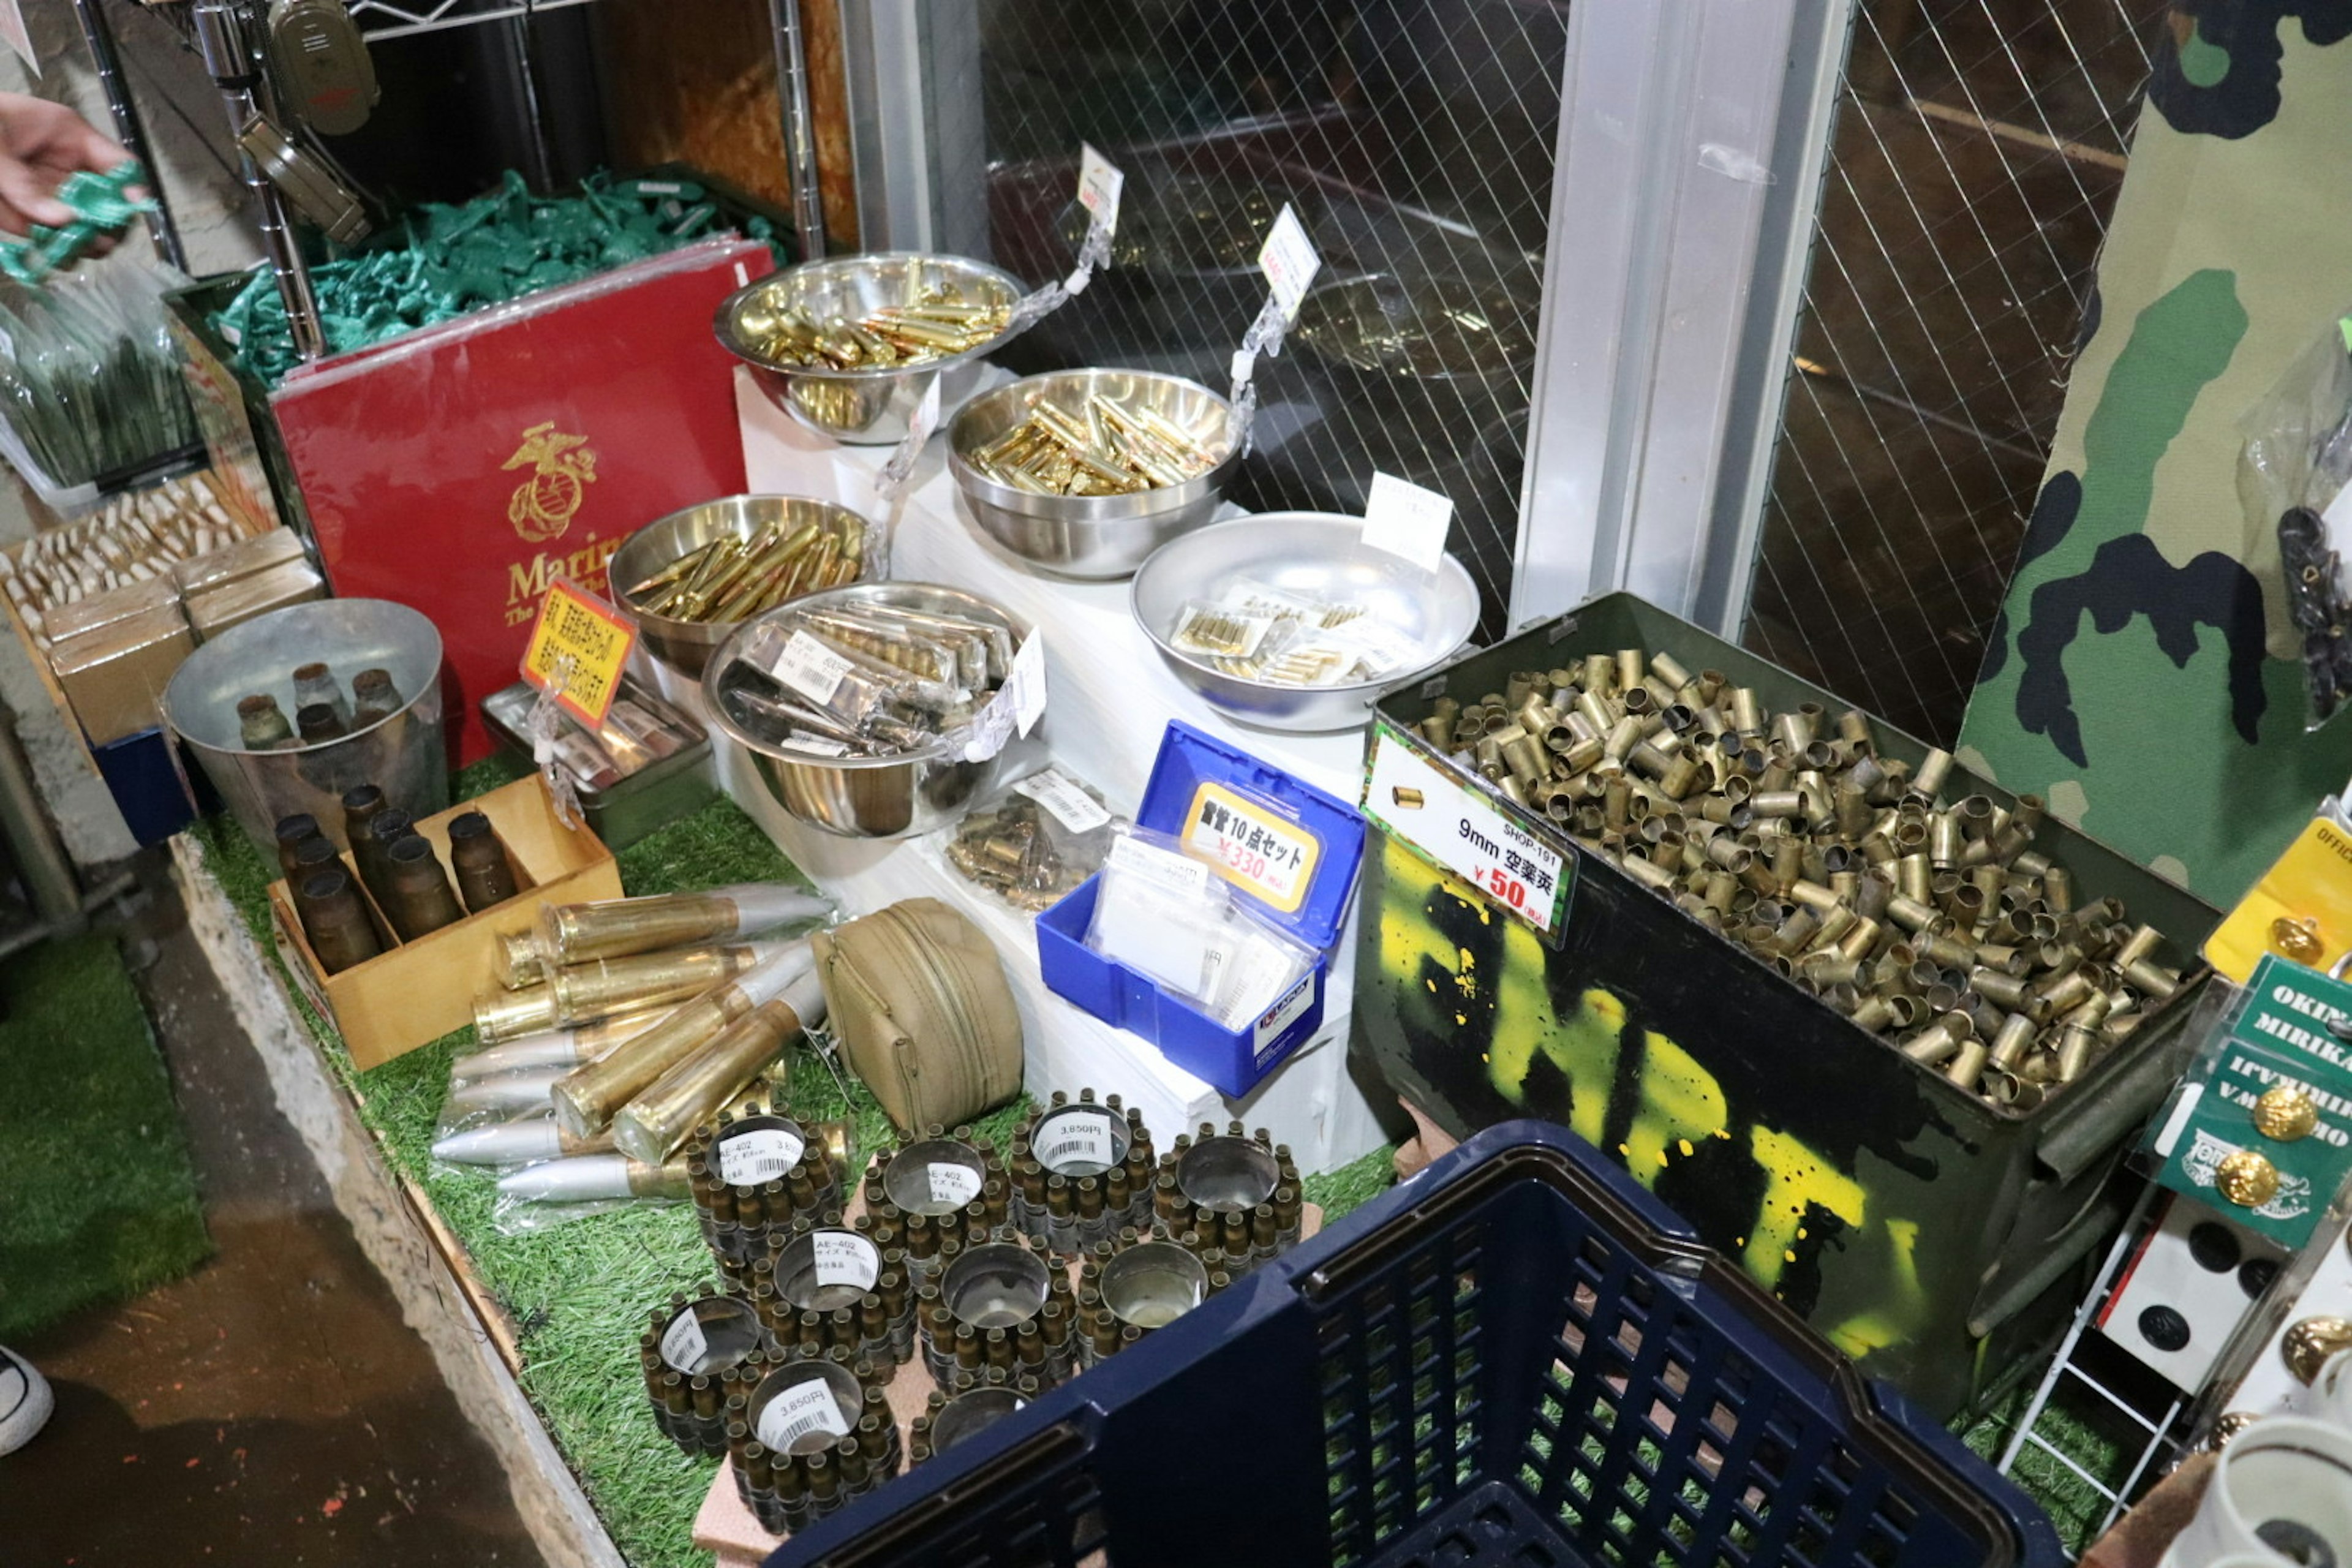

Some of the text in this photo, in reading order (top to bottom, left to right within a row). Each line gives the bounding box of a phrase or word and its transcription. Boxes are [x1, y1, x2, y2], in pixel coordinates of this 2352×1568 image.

[507, 531, 635, 606] Marin
[505, 606, 534, 627] The
[1459, 818, 1554, 896] 9mm 空薬莢
[1504, 824, 1556, 867] SHOP-191
[1061, 1125, 1101, 1136] 3,850円
[817, 1241, 856, 1250] AE-402
[780, 1390, 826, 1417] 3,850円
